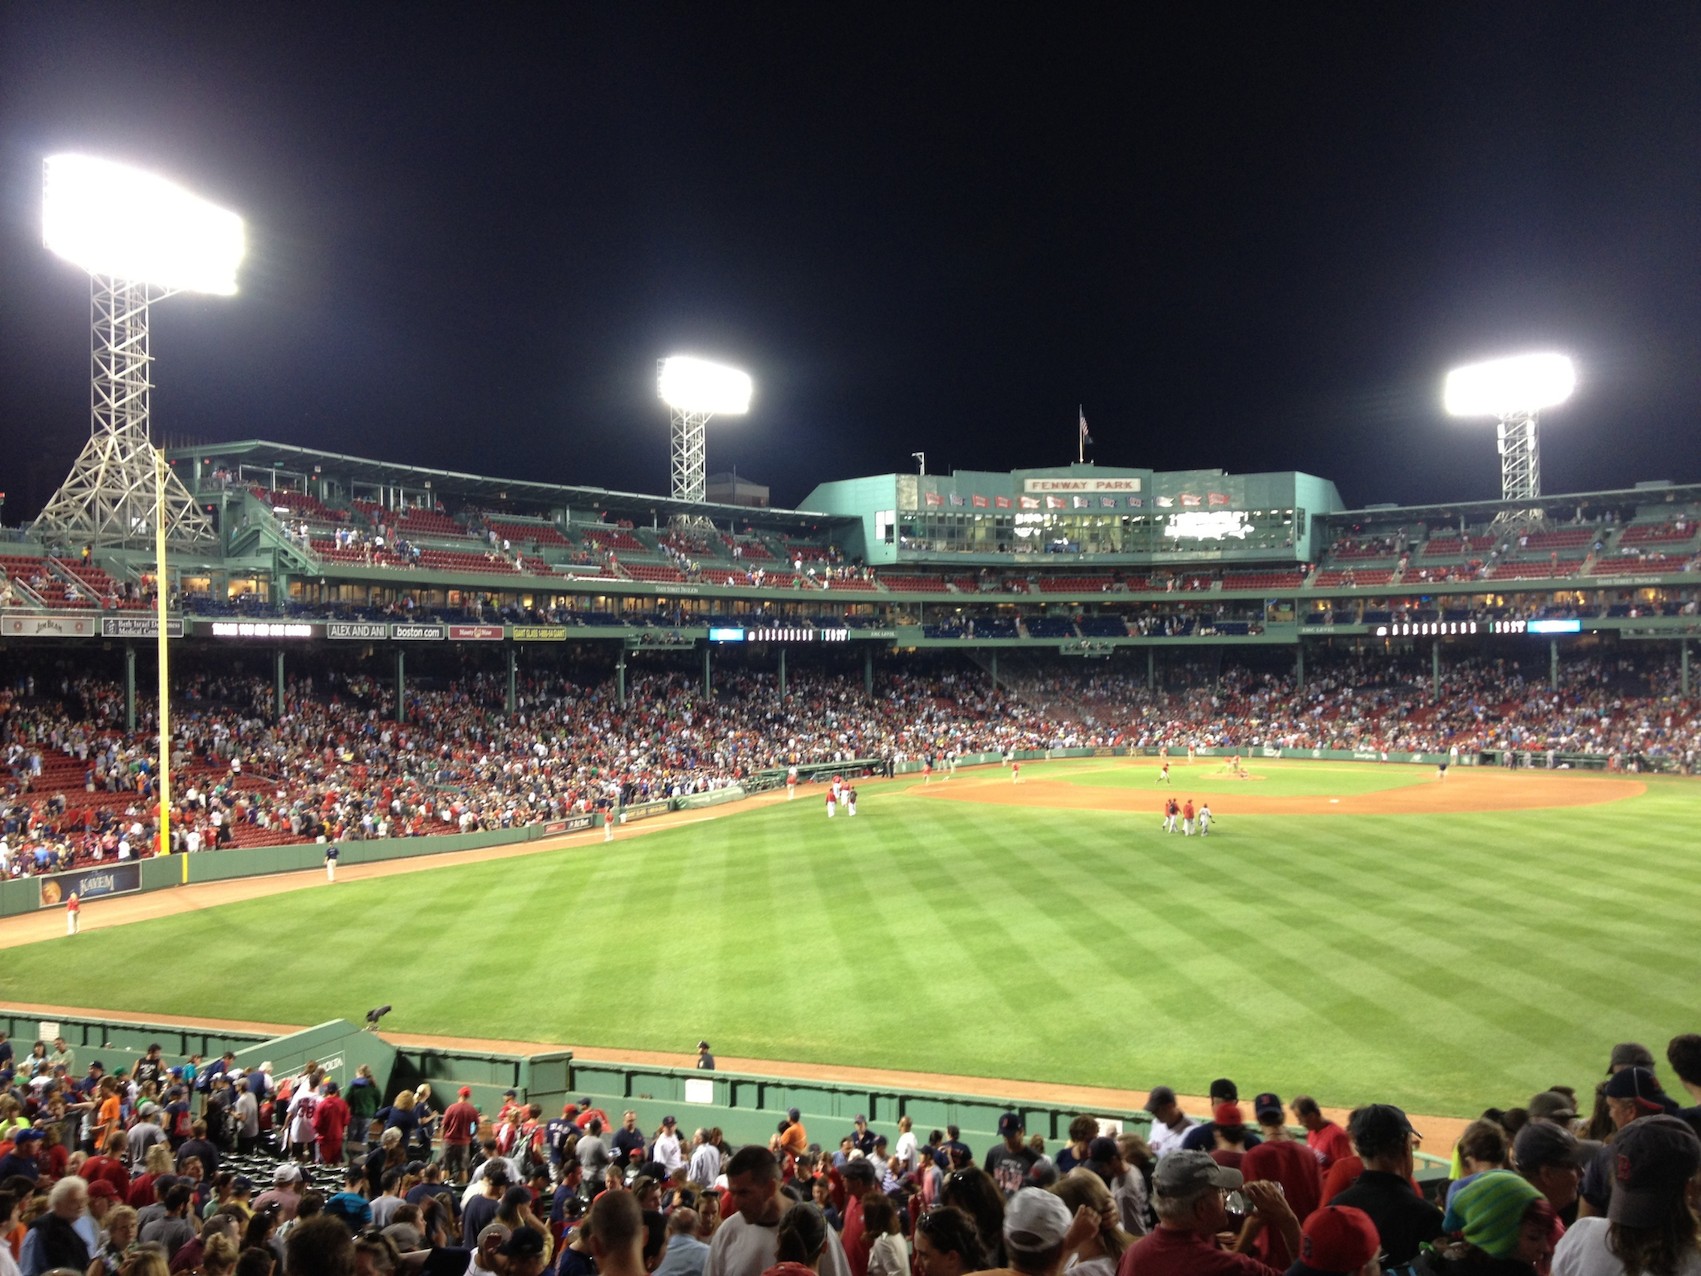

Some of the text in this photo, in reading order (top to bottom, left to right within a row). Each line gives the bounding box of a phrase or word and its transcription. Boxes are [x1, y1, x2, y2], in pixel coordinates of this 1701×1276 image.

[1032, 481, 1133, 490] FENWAY PARK
[331, 625, 384, 637] ALEX AND ANI
